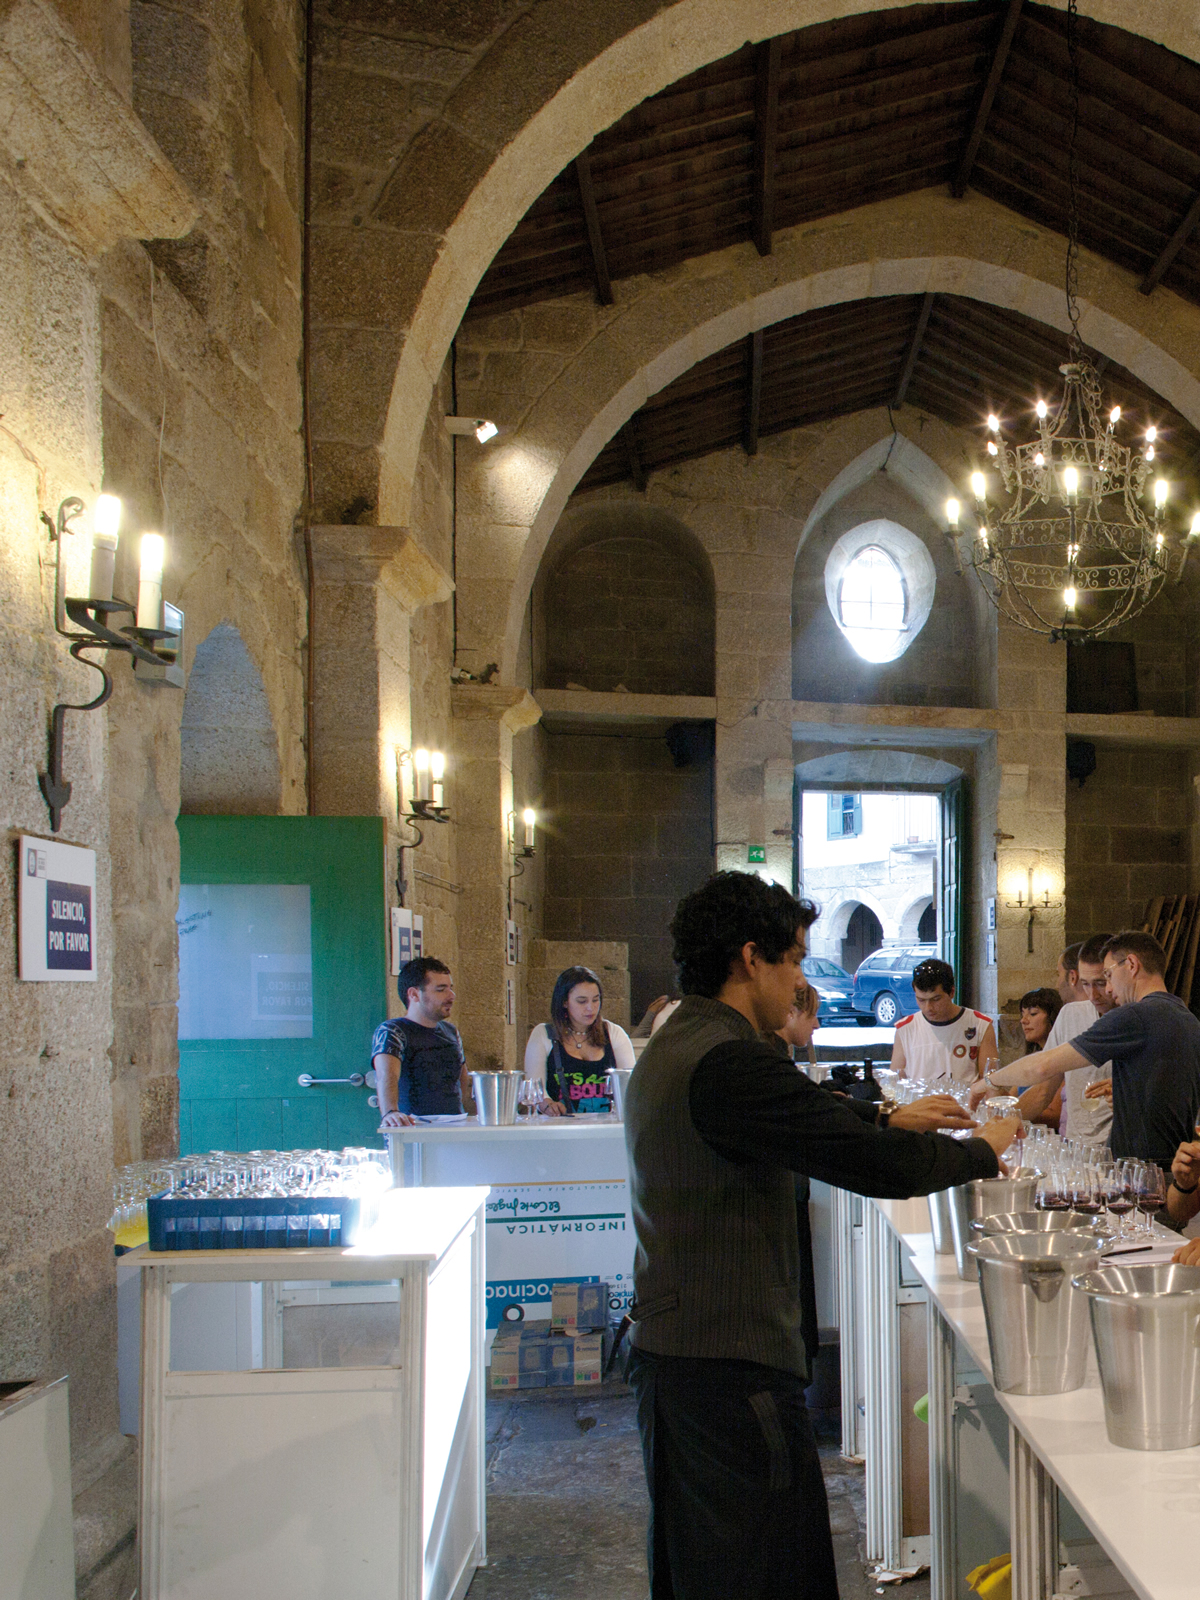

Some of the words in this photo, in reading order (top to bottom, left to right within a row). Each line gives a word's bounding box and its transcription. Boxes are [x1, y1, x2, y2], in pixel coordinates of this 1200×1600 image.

[51, 899, 86, 925] SILENCIO,
[49, 931, 65, 950] POR
[65, 932, 90, 952] FAVOR
[553, 1072, 584, 1085] I'S
[558, 1083, 607, 1100] BOU
[520, 1201, 548, 1213] Corte
[549, 1200, 561, 1213] El
[506, 1221, 626, 1235] INFORMÁTICA
